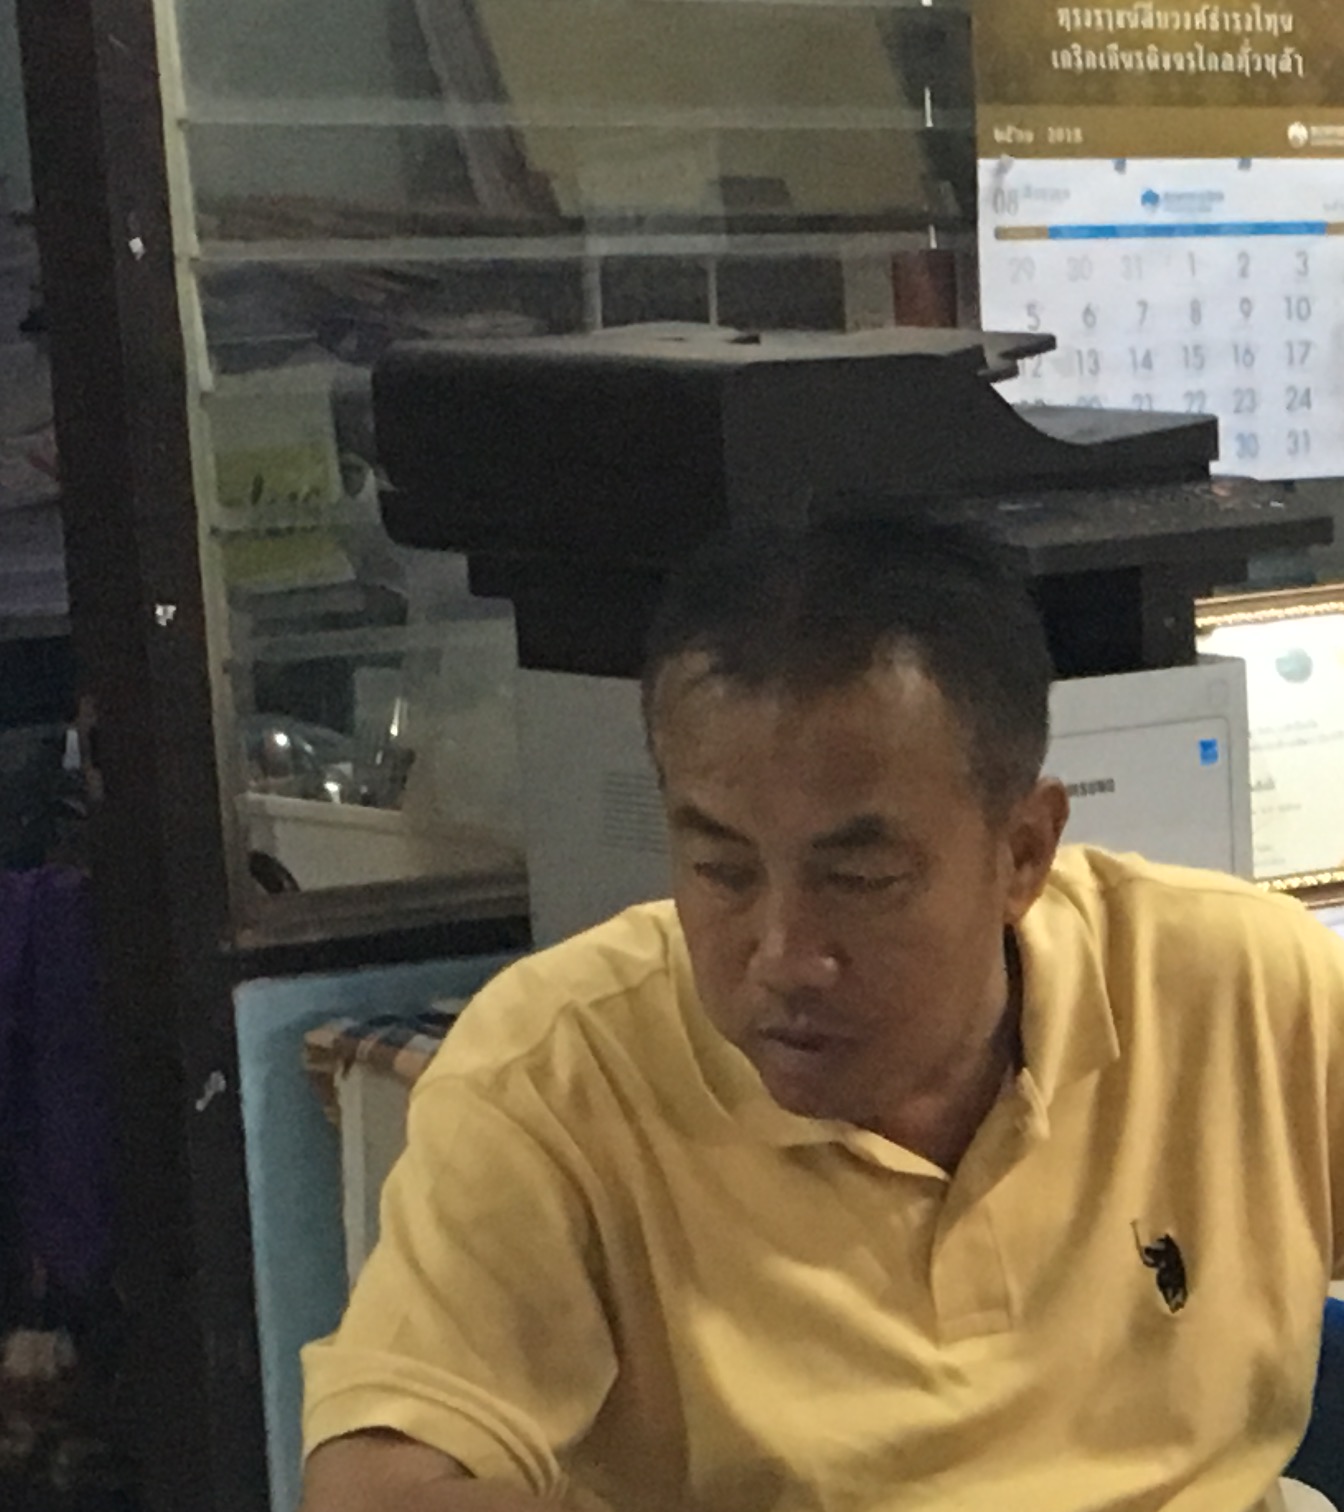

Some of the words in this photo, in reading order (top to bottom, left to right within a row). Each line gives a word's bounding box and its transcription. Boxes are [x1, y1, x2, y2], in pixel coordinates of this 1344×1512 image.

[1237, 251, 1252, 279] 2
[1295, 250, 1311, 278] 3
[1026, 302, 1042, 333] 5
[1082, 302, 1098, 329] 6
[1136, 300, 1150, 327] 7
[1238, 297, 1254, 323] 9
[1284, 296, 1313, 323] 10
[1075, 348, 1101, 377] 13
[1129, 346, 1154, 375] 14
[1182, 345, 1207, 371] 15
[1232, 342, 1257, 368] 16
[1286, 340, 1312, 367] 17
[1232, 387, 1258, 415] 23
[1286, 386, 1313, 412] 24
[1235, 432, 1261, 461] 30
[1286, 430, 1312, 458] 31
[1066, 777, 1116, 798] MSUNG
